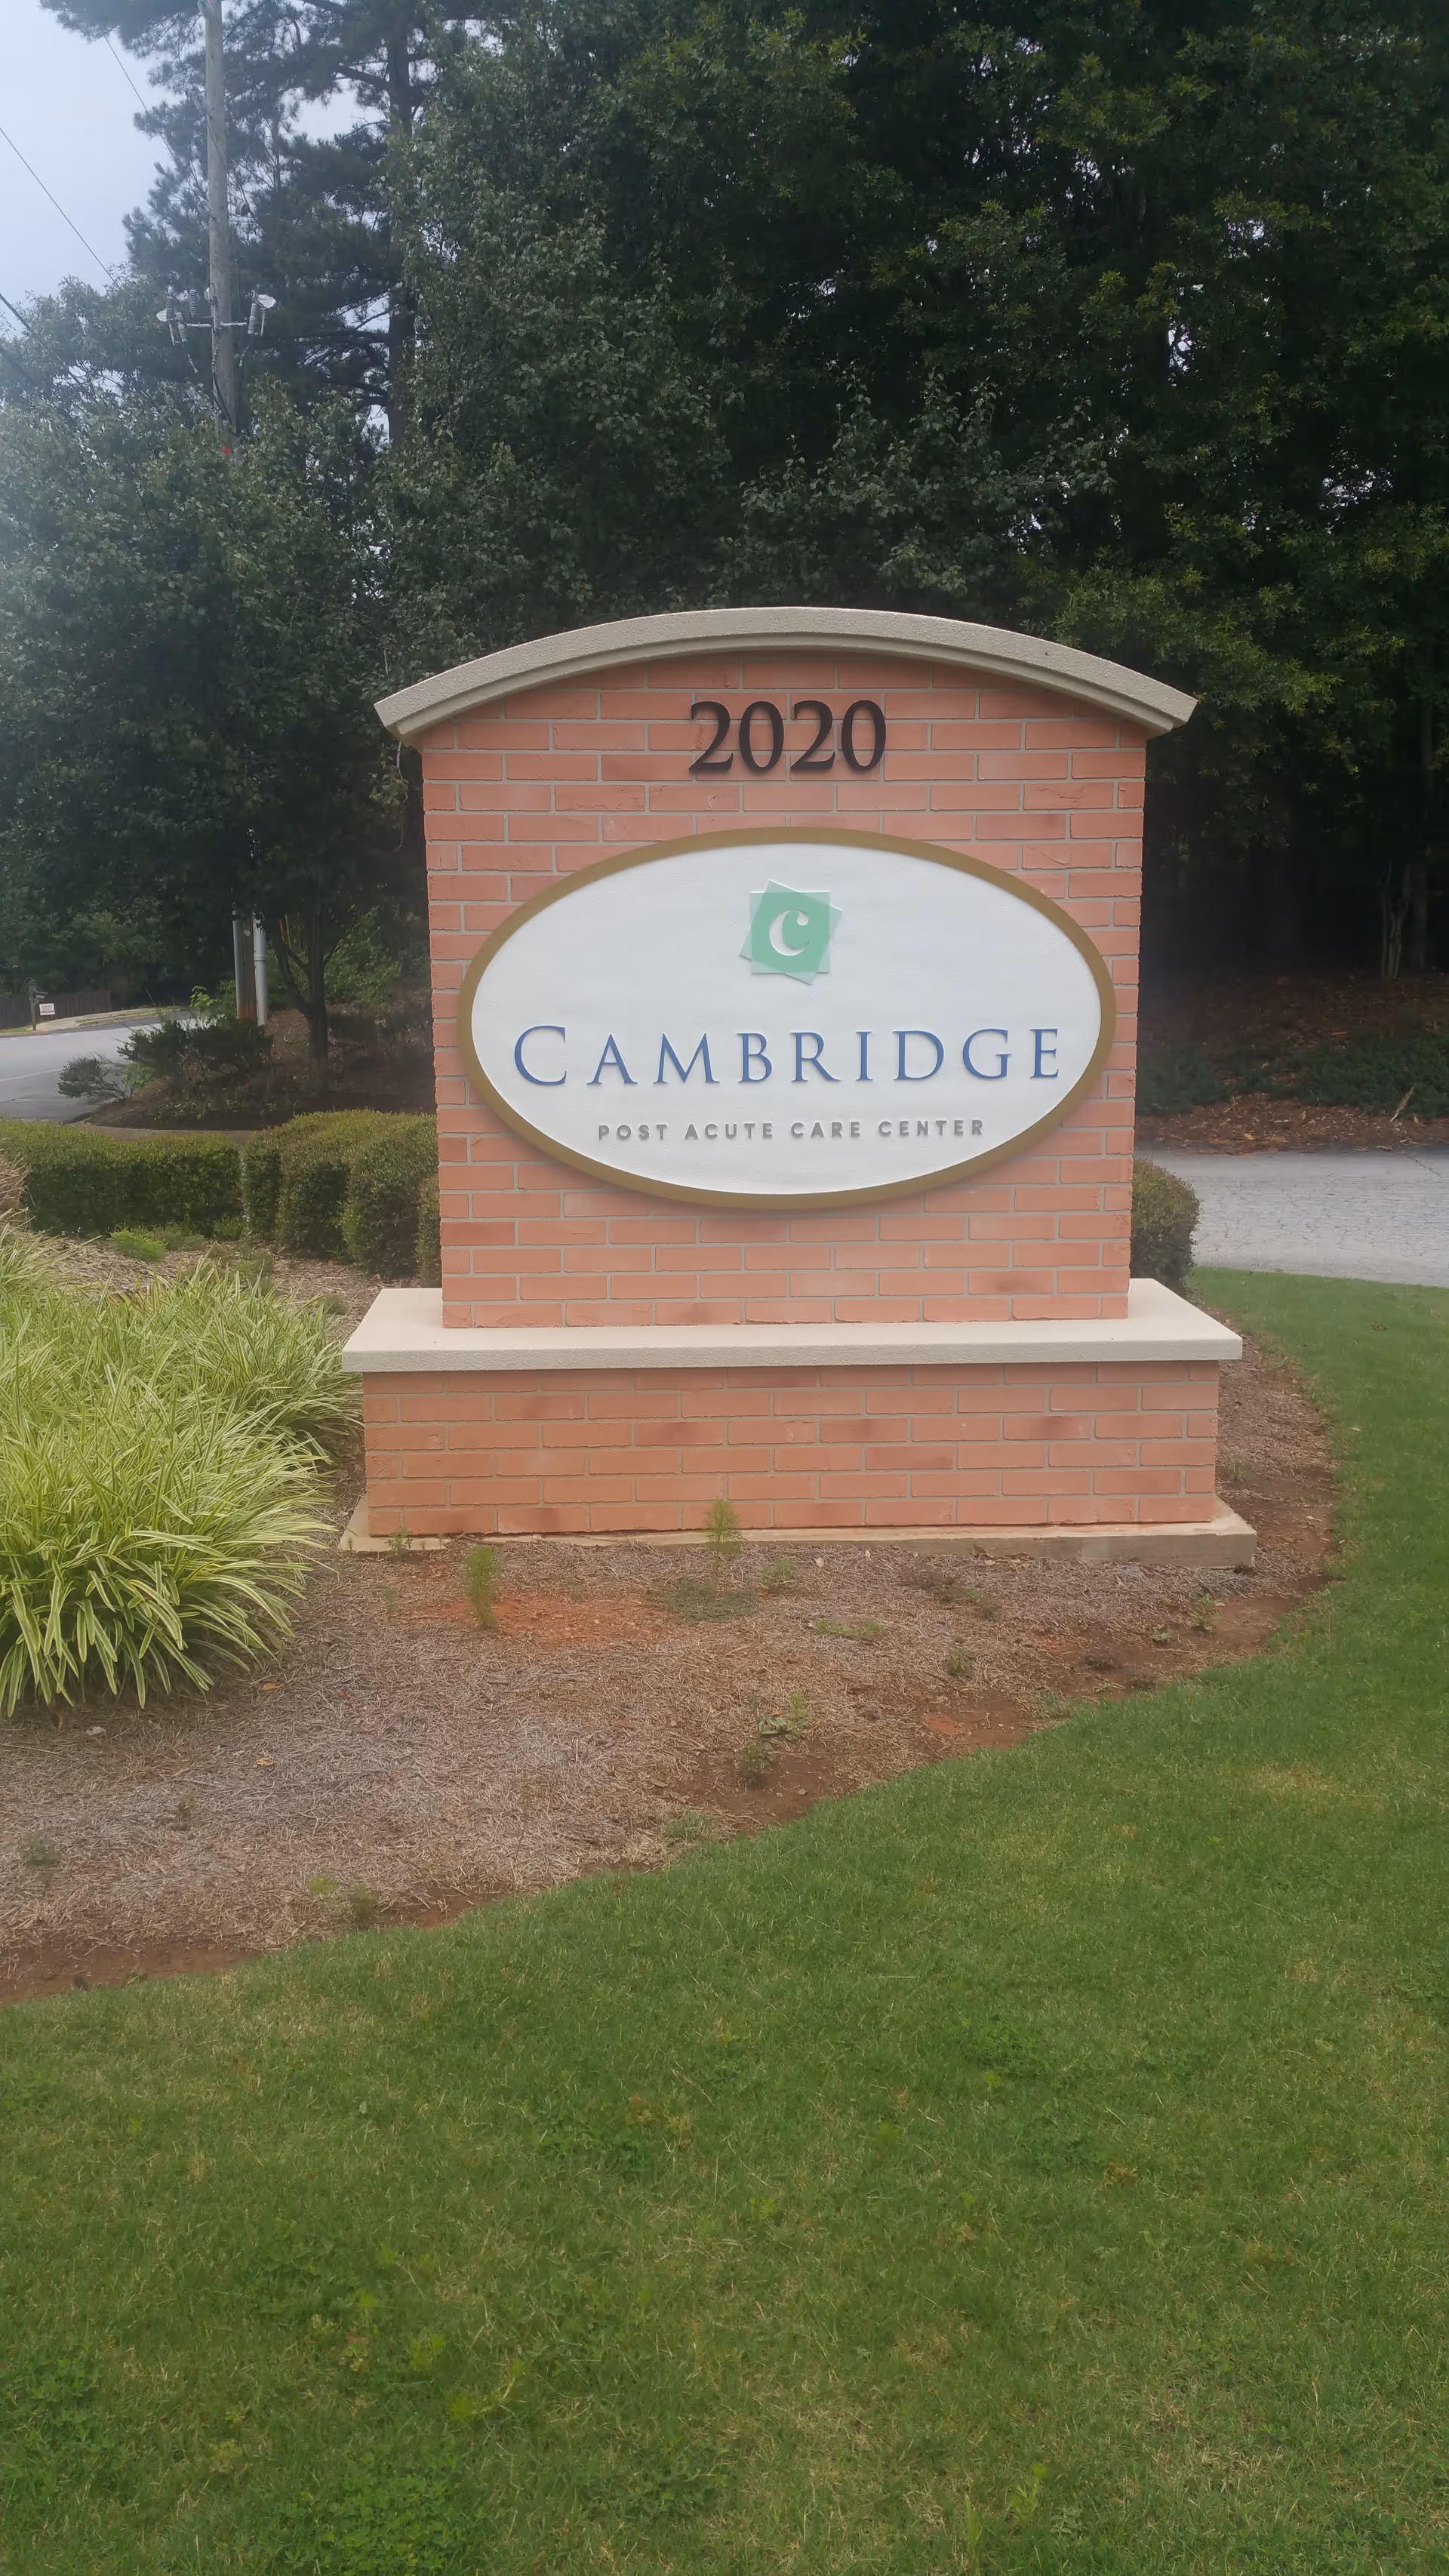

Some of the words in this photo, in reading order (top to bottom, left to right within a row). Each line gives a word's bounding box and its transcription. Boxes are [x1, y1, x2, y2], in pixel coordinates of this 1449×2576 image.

[689, 700, 887, 771] 2020
[513, 1024, 1060, 1087] CAMBRIDGE
[598, 1124, 667, 1140] POST
[685, 1123, 773, 1139] ACUTE
[790, 1122, 860, 1137] CARE
[878, 1120, 984, 1137] CENTER
